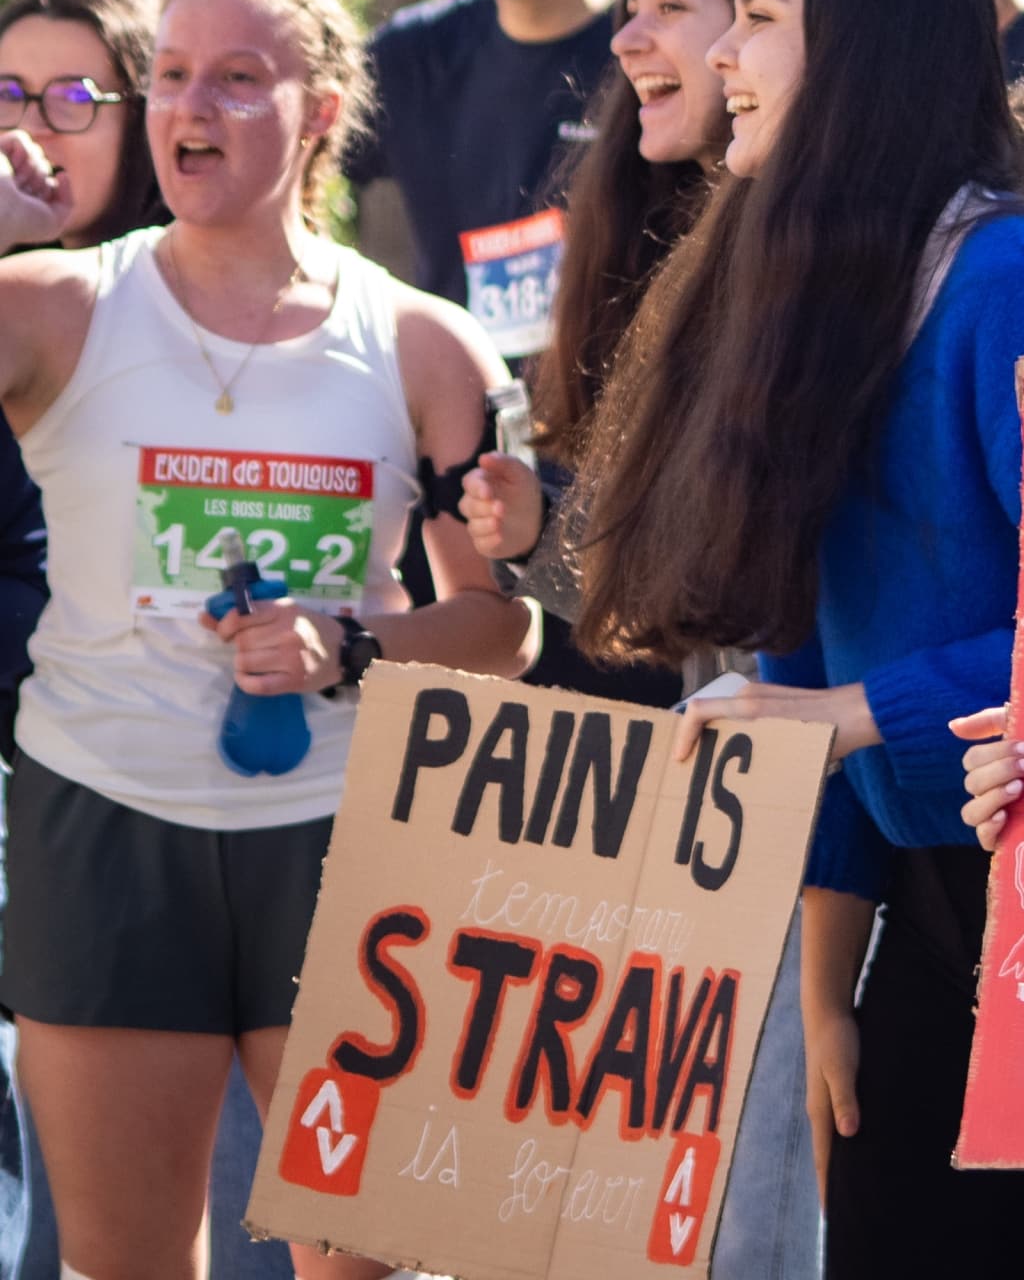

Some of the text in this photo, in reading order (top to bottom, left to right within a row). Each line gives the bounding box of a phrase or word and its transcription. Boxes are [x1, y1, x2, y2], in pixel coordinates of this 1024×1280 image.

[154, 452, 229, 485] EKIDEN
[232, 459, 262, 487] de
[204, 498, 313, 522] LES BOSS LADIES
[153, 523, 355, 586] 142-2
[391, 687, 753, 892] PAIN IS
[327, 904, 742, 1142] STRAVA
[398, 1104, 460, 1189] is
